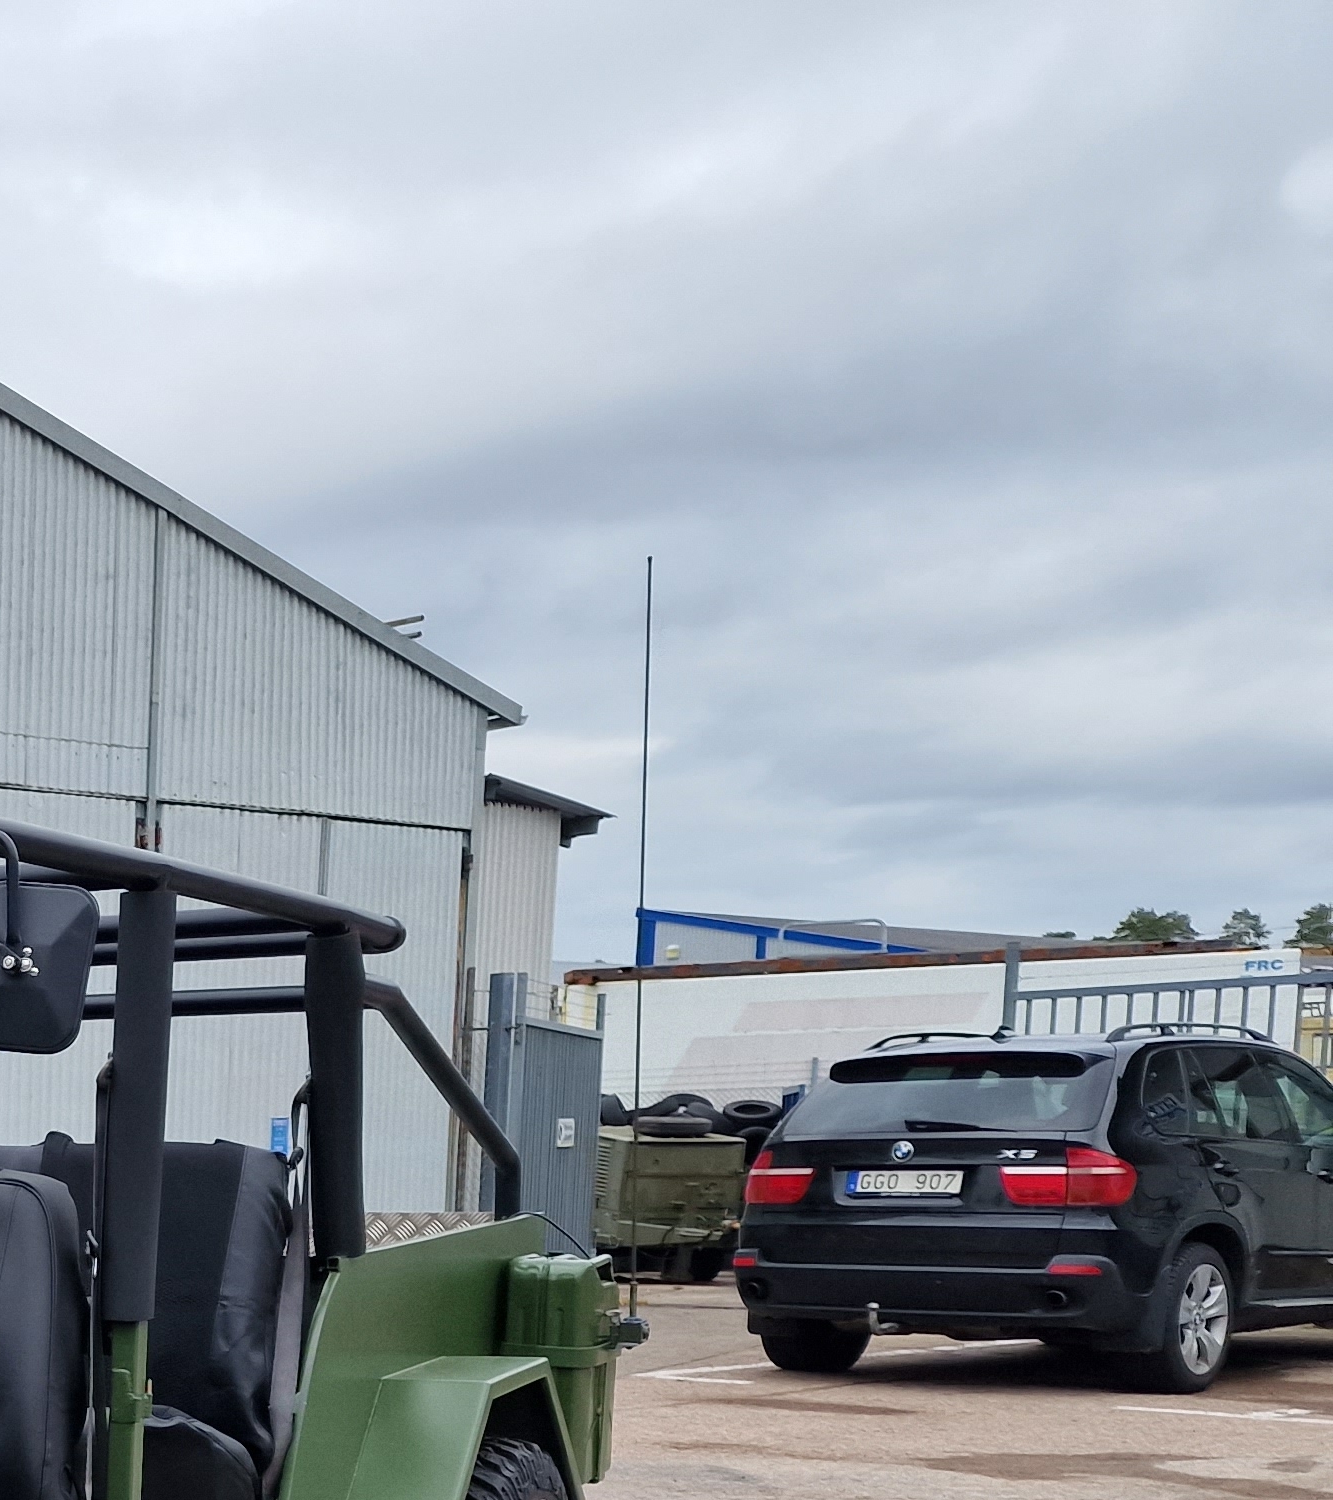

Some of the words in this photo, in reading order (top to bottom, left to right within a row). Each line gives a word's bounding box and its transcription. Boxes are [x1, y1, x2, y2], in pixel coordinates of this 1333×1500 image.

[1244, 959, 1284, 972] FRC
[996, 1149, 1038, 1159] X5
[860, 1173, 899, 1190] GGO
[915, 1173, 957, 1190] 907
